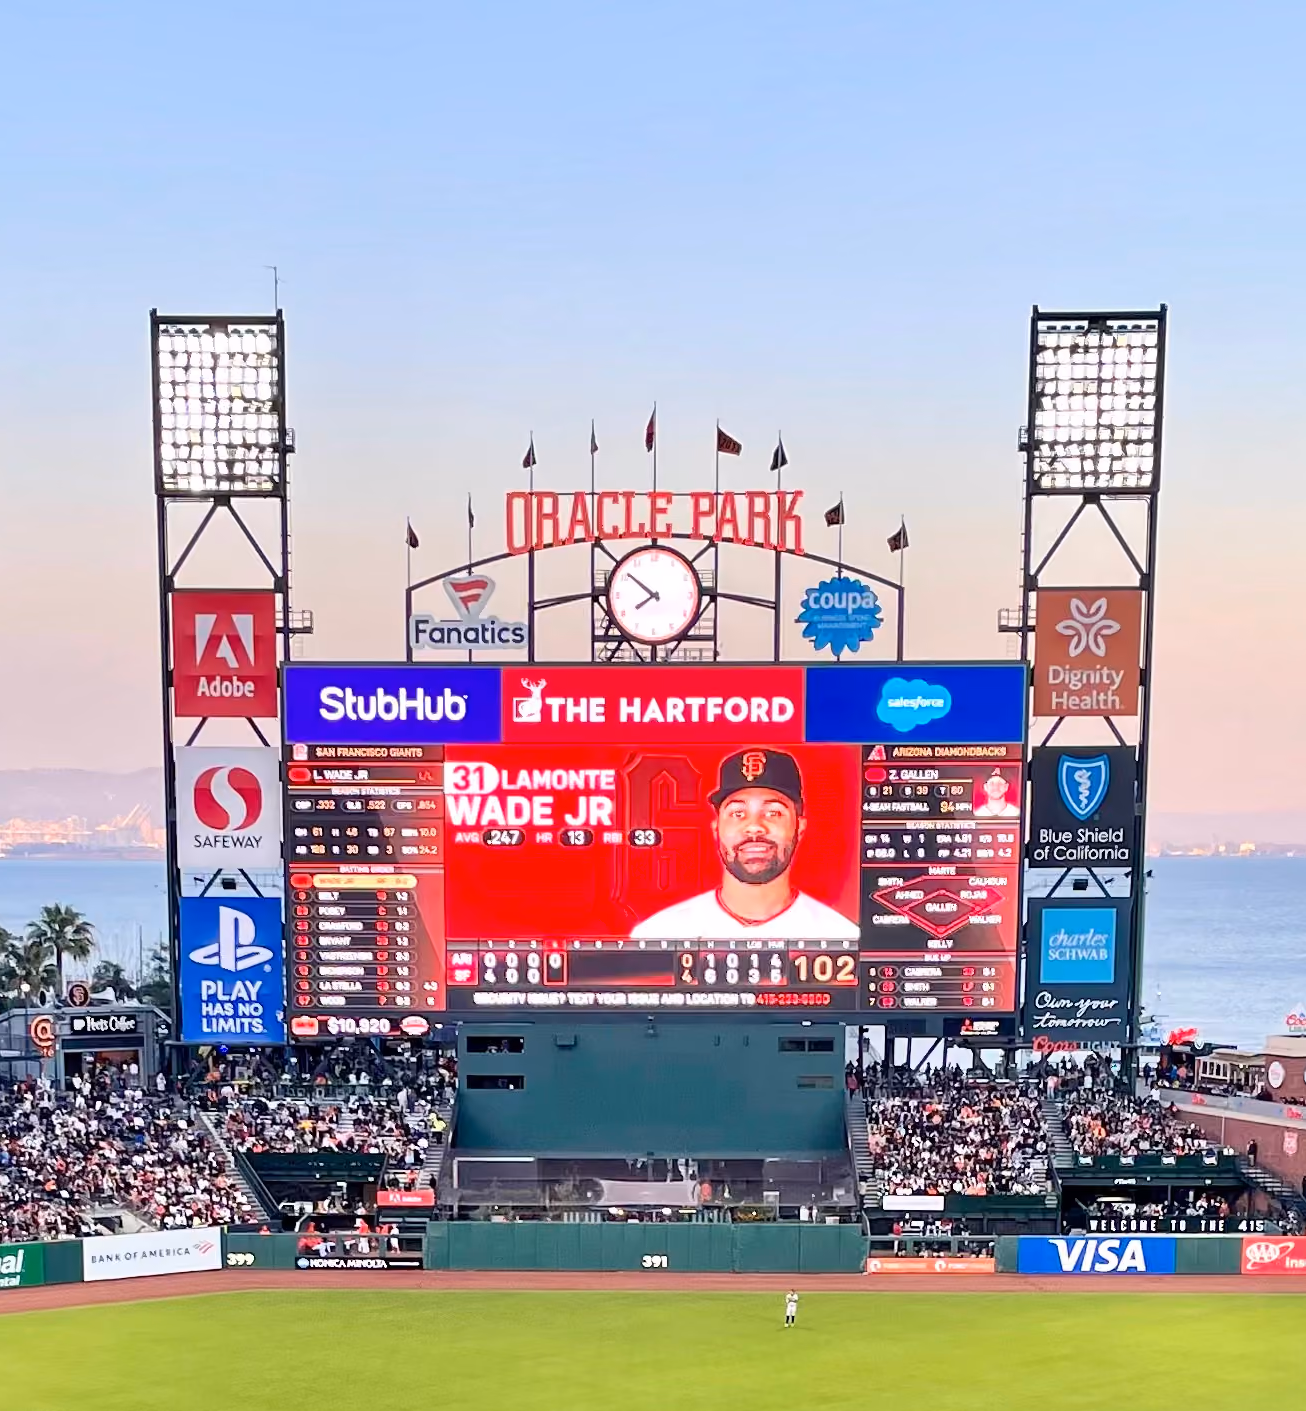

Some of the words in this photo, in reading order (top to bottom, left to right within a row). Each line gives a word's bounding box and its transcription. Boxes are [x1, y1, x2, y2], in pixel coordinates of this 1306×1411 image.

[506, 490, 672, 556] ORACLE
[690, 490, 805, 556] PARK
[808, 591, 874, 615] coupa
[415, 619, 525, 646] Fanatics
[1048, 665, 1125, 689] Dignity
[197, 675, 255, 698] Adobe
[319, 686, 466, 722] StubHub
[887, 694, 945, 708] salesforce
[1051, 691, 1122, 710] Health
[546, 696, 605, 723] THE
[620, 696, 795, 723] HARTFORD
[315, 747, 336, 757] SAN
[337, 747, 388, 757] FRANCISCO
[389, 747, 423, 757] GIANTS
[892, 746, 933, 757] ARIZONA
[935, 746, 1007, 757] DIAMONDBACKS
[324, 769, 353, 780] WADE
[354, 769, 369, 780] JR
[452, 764, 485, 790] 31
[501, 769, 616, 790] LAMONTE
[900, 769, 939, 780] GALLEN
[446, 795, 554, 826] WADE
[564, 795, 613, 826] JR
[193, 834, 263, 849] SAFEWAY
[455, 832, 479, 844] AVG
[486, 830, 520, 845] .247
[536, 832, 553, 844] HR
[567, 830, 585, 845] 13
[603, 832, 622, 844] RBI
[633, 830, 656, 845] 33
[1039, 828, 1072, 843] Blue
[1076, 828, 1124, 843] Shield
[418, 844, 438, 855] 24.2
[1033, 845, 1051, 861] of
[1053, 845, 1130, 861] California
[1048, 927, 1109, 948] charles
[1047, 949, 1109, 962] SCHWAB
[201, 980, 262, 1001] PLAY
[567, 992, 595, 1004] TEXT
[596, 993, 626, 1005] YOUR
[661, 993, 685, 1005] AND
[686, 993, 739, 1005] LOCATION
[740, 993, 756, 1005] TO
[201, 1002, 232, 1017] HAS
[236, 1002, 263, 1017] NO
[1035, 991, 1074, 1010] Own
[1074, 997, 1119, 1018] your
[109, 1015, 135, 1031] Coffee
[327, 1016, 391, 1035] $10,920
[1033, 1013, 1122, 1030] tomorrow
[1032, 1034, 1078, 1052] Coors
[1079, 1040, 1120, 1051] LIGHT
[1089, 1219, 1157, 1232] WELCOME
[1169, 1219, 1187, 1232] TO
[1200, 1219, 1225, 1232] THE
[1237, 1219, 1264, 1232] 415
[90, 1252, 122, 1264] BANK
[125, 1251, 139, 1262] OF
[140, 1247, 191, 1260] AMERICA
[227, 1252, 255, 1267] 399
[642, 1254, 668, 1268] 391
[1048, 1239, 1147, 1273] VISA
[310, 1259, 346, 1269] KONICA
[347, 1259, 388, 1269] MINOLTA
